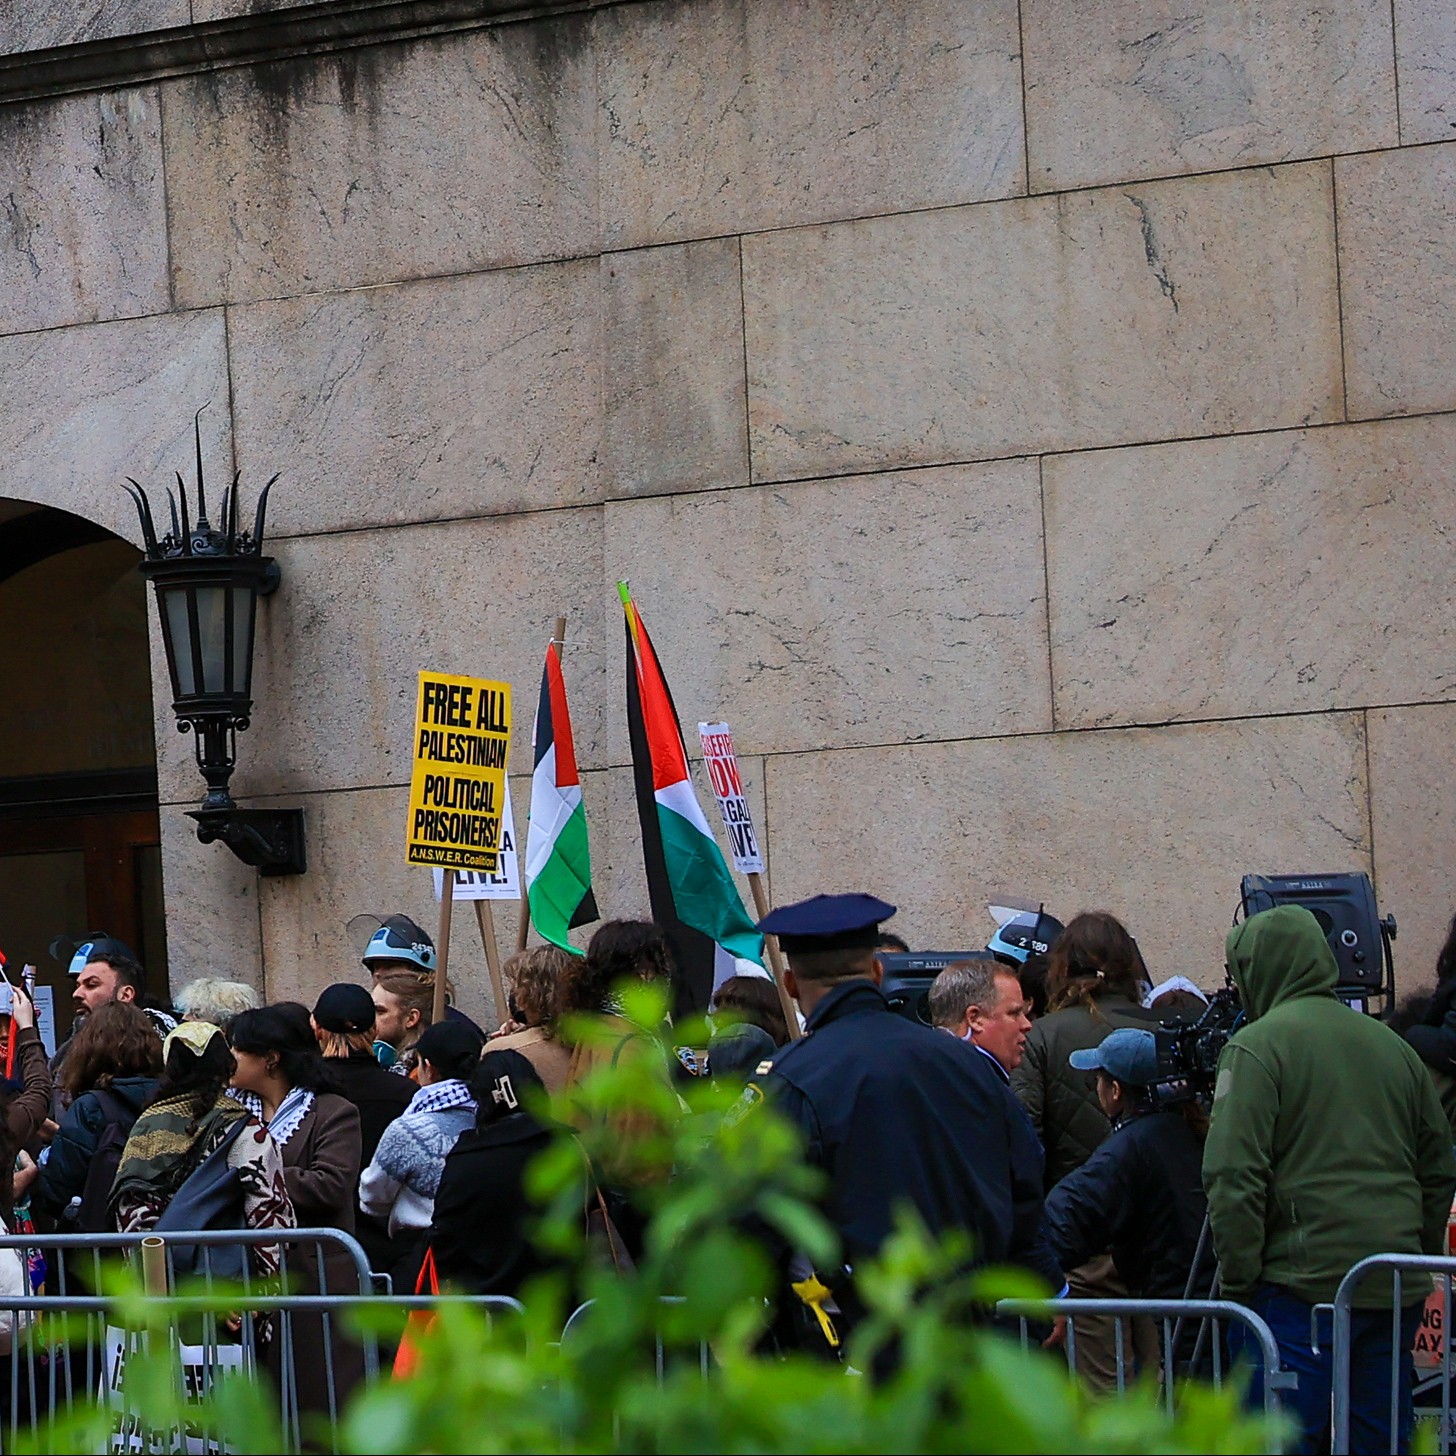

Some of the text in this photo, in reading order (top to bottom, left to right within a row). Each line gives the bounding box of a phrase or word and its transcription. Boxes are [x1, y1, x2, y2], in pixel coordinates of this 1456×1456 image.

[422, 681, 508, 733] FREE ALL
[418, 729, 507, 769] PALESTINIAN
[423, 774, 495, 813] POLITICAL
[413, 808, 499, 848] PRISONERS!
[410, 847, 495, 867] A.N.S.W.E.R. Coalition
